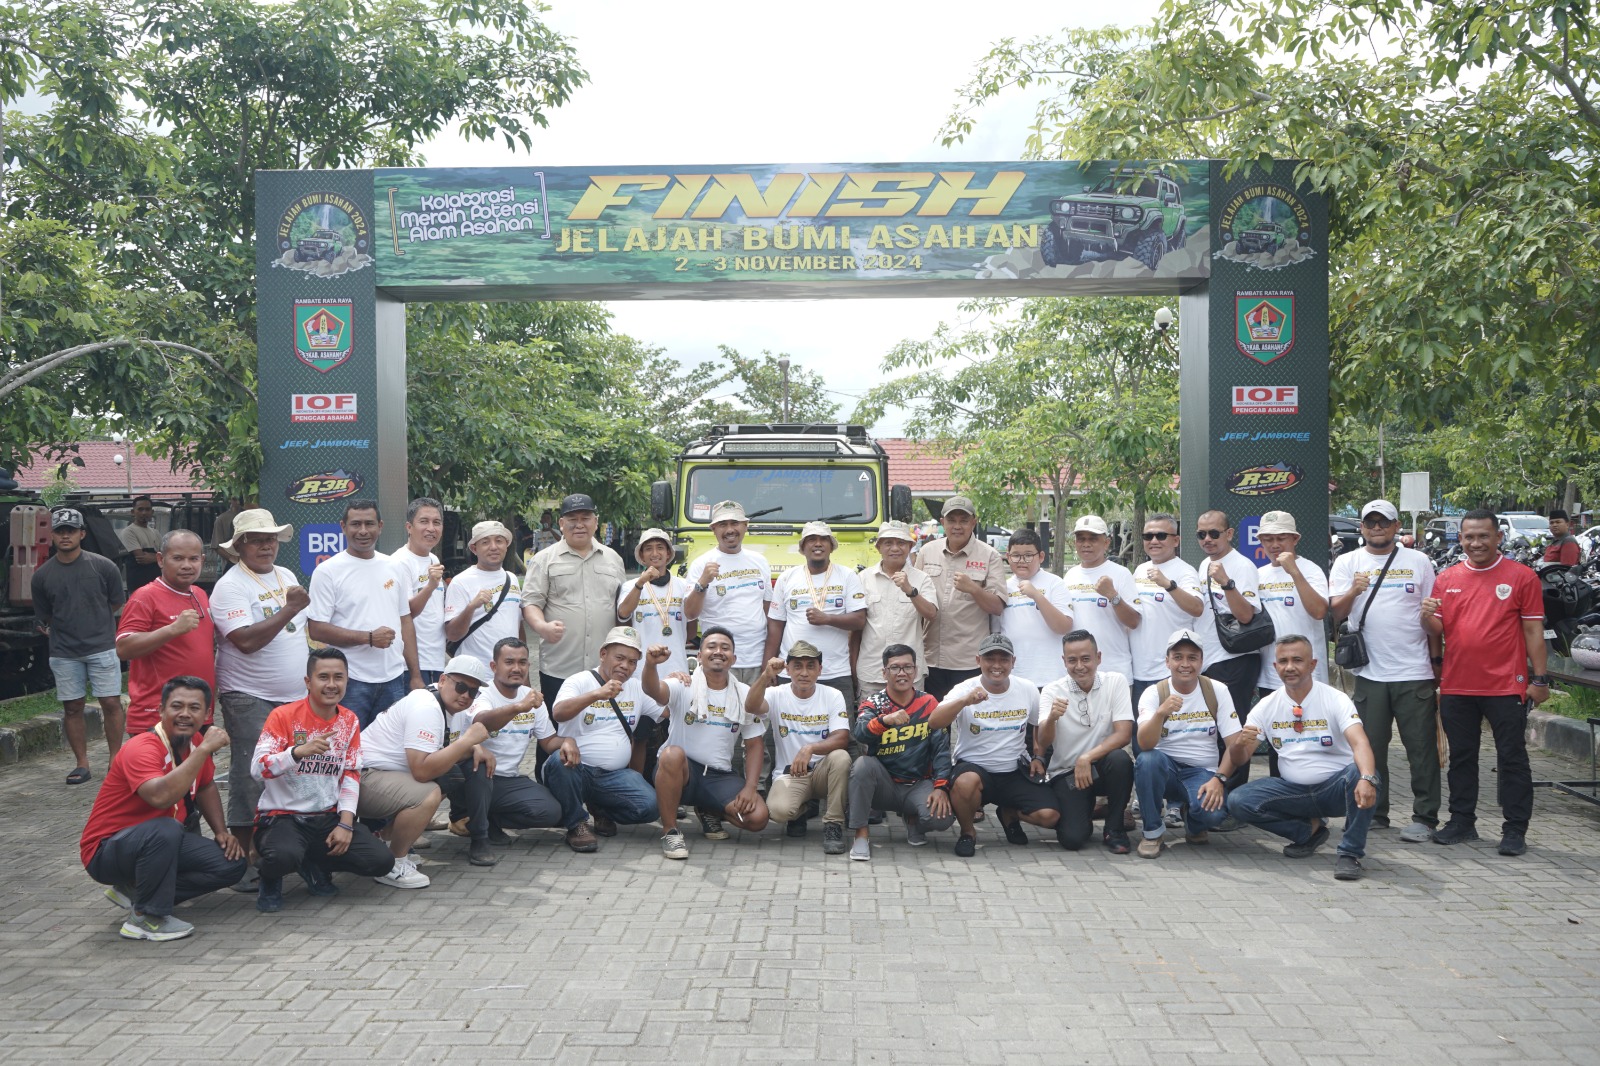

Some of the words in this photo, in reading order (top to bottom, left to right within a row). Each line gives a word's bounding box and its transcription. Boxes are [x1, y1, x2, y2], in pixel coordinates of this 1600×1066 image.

[421, 186, 516, 212] Kolaborasi
[567, 171, 1027, 220] FINISH
[279, 204, 301, 237] JELAJAH
[302, 194, 322, 207] BUMI
[324, 194, 354, 214] ASAHAN
[351, 211, 366, 236] 2024
[400, 201, 467, 229] Meraih
[470, 198, 540, 220] Potensi
[1221, 195, 1244, 229] JELAJAH
[1244, 186, 1264, 199] BUMI
[1267, 186, 1297, 205] ASAHAN
[1294, 204, 1309, 228] 2024
[409, 225, 457, 243] Alam
[460, 216, 534, 238] Asahan
[554, 226, 722, 254] JELAJAH
[743, 225, 851, 250] BUMI
[868, 224, 1039, 250] ASAHAN
[674, 257, 688, 272] 2
[714, 256, 727, 271] 3
[734, 256, 857, 271] NOVEMBER
[863, 255, 923, 270] 2024
[295, 395, 354, 410] IOF
[1235, 388, 1295, 402] IOF
[280, 440, 309, 449] JEEP
[310, 440, 370, 449] JAMBOREE
[1220, 432, 1249, 441] JEEP
[1251, 432, 1311, 440] JAMBOREE
[728, 469, 763, 482] JEEP
[763, 469, 835, 482] JAMBOREE
[1237, 471, 1292, 486] R3H
[296, 479, 352, 494] R3H
[308, 533, 344, 553] BRI
[298, 761, 342, 775] ASAHAN
